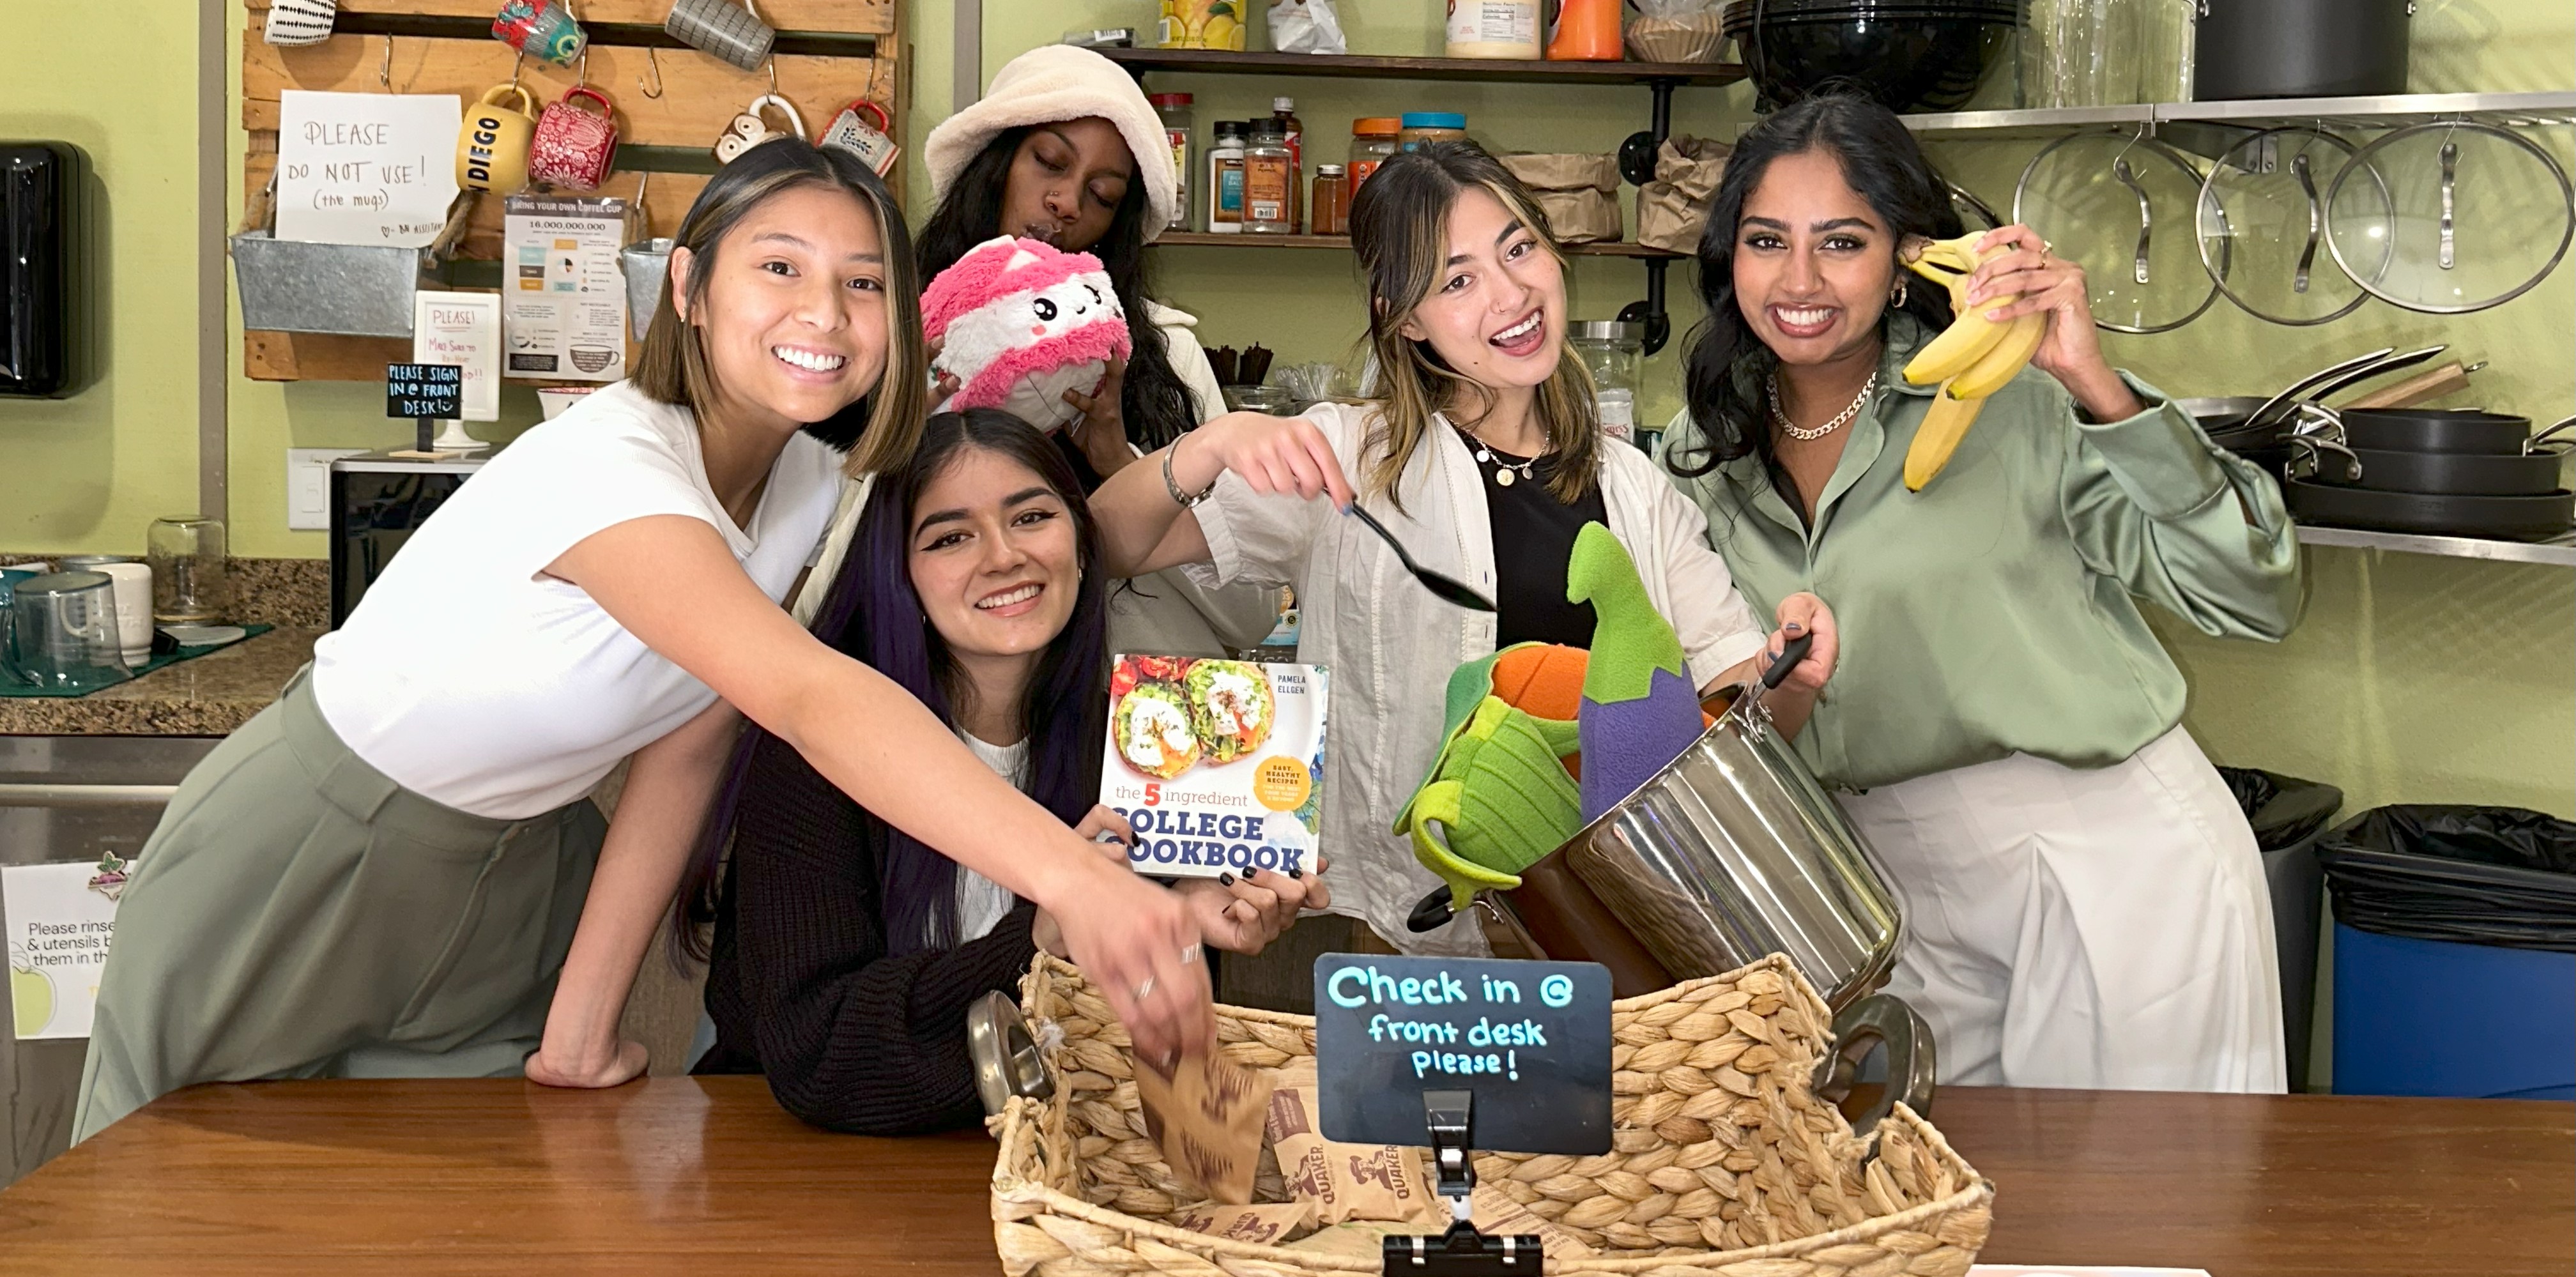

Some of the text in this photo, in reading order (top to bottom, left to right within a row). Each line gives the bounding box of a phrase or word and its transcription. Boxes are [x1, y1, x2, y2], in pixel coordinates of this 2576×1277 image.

[303, 121, 390, 146] PLEASE
[468, 118, 501, 182] DIEGO
[288, 164, 309, 180] DO
[326, 161, 372, 183] NOT
[314, 188, 389, 212] (the mugs)
[512, 200, 622, 213] BRING YOUR OWN COFFEE CUP
[433, 310, 475, 325] PLEASE!
[388, 365, 459, 381] PLEASE SIGN
[389, 383, 459, 397] IN @ FRONT
[404, 399, 442, 415] DESK!
[1278, 675, 1306, 684] PAMELA
[1278, 685, 1305, 694] ELLGEN
[1116, 783, 1248, 806] the 5 ingredient
[29, 920, 115, 935] Please rinse
[27, 938, 39, 951] &
[44, 935, 100, 951] utensils
[33, 951, 107, 966] them in th
[1328, 966, 1574, 1007] Check in @
[1368, 1014, 1547, 1046] front desk
[1310, 1144, 1335, 1205] QUAKER
[1385, 1145, 1411, 1200] QUAKER
